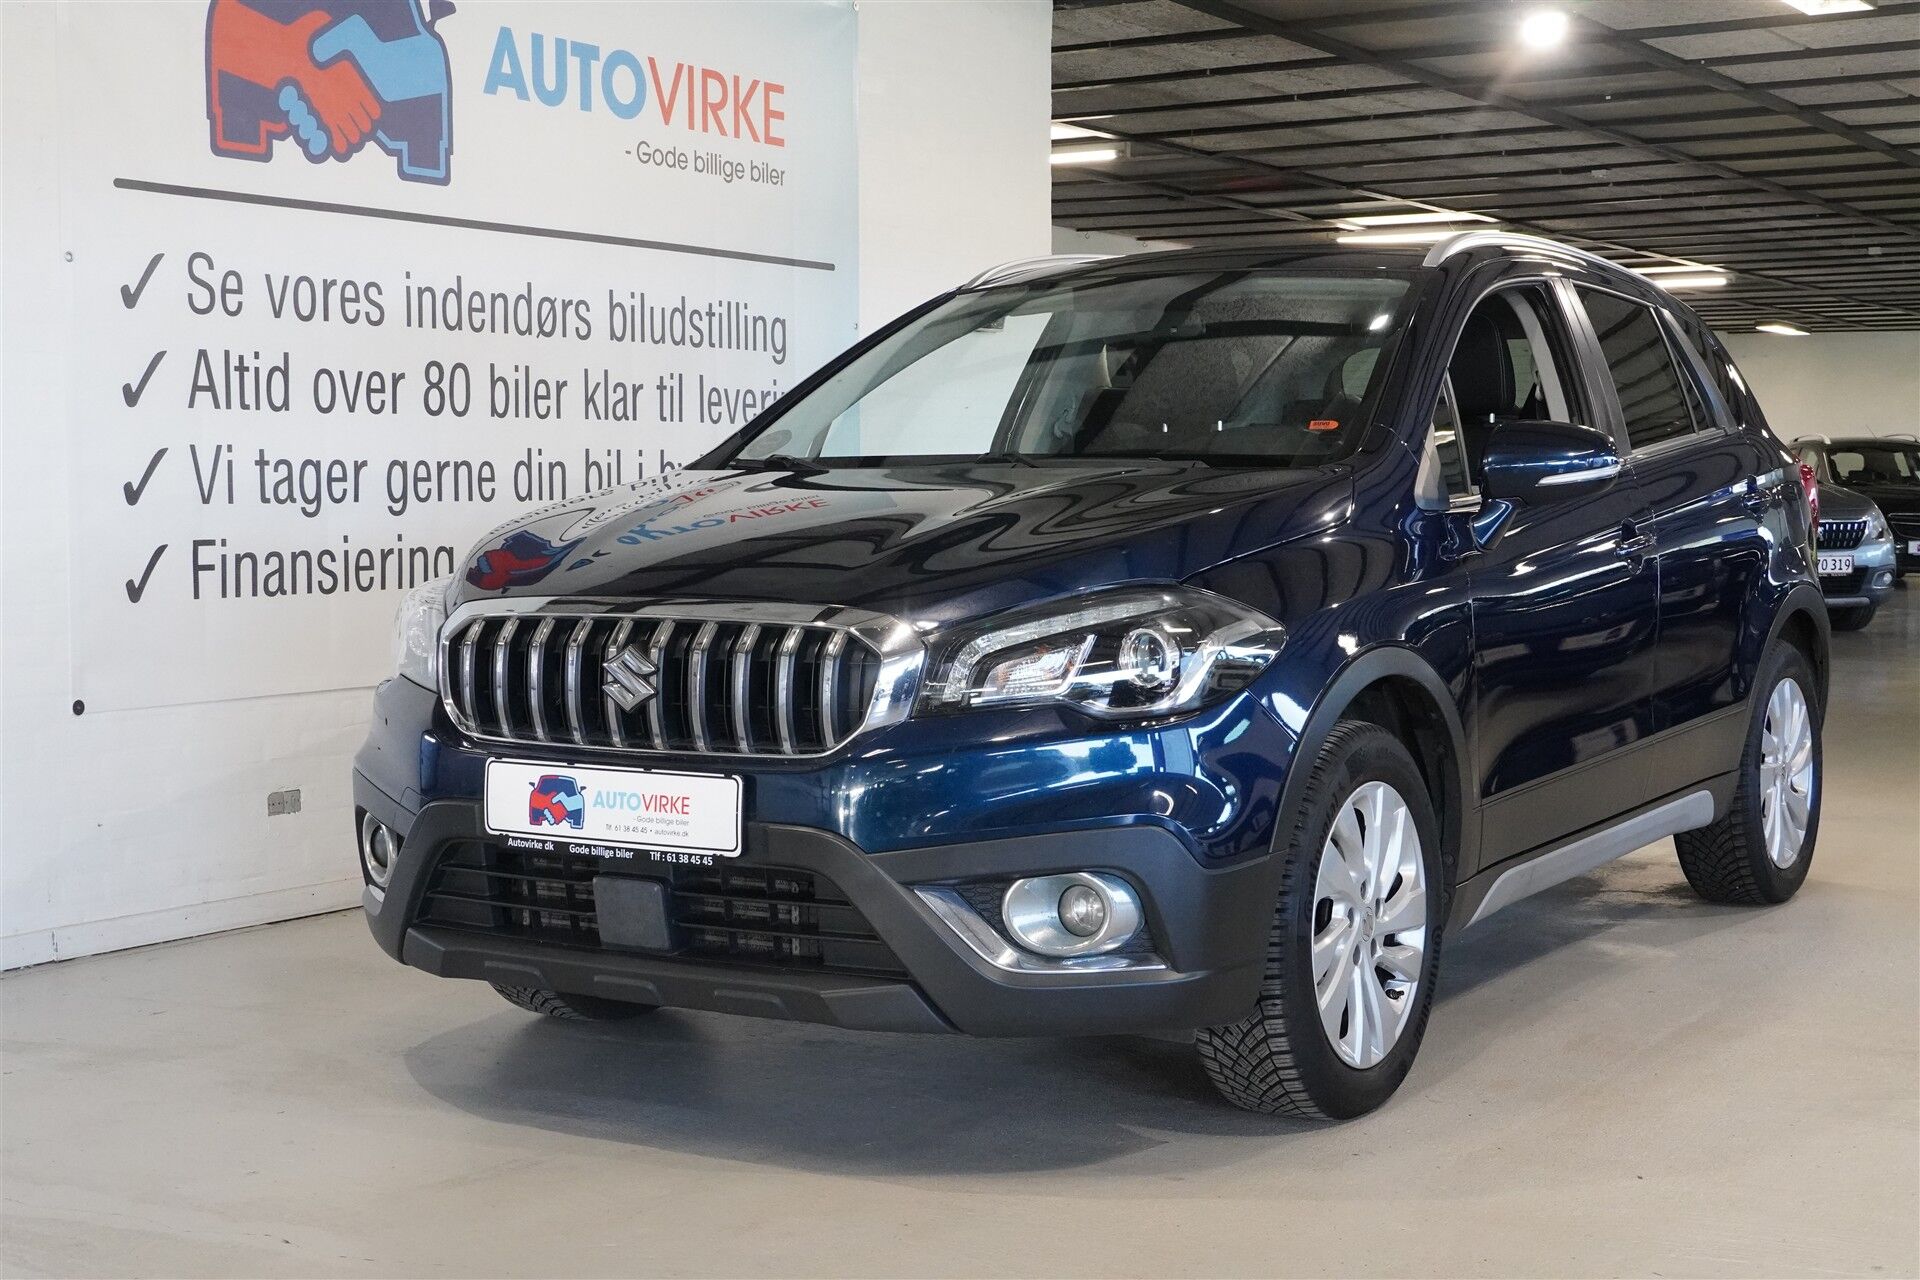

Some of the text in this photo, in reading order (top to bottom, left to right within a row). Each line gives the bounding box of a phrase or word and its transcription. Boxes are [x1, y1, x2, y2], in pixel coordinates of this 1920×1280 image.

[483, 26, 786, 148] AUTOVIRKE
[636, 140, 689, 170] Gode
[693, 149, 745, 183] billige
[750, 160, 785, 187] biler
[187, 252, 786, 364] Se vores indendørs biludstilling
[188, 349, 290, 412] Altid
[314, 369, 406, 416] over
[424, 361, 471, 417] 80
[490, 363, 568, 419] biler
[584, 368, 644, 422] klar
[657, 373, 683, 422] til
[190, 445, 234, 505] Vi
[255, 449, 368, 518] tager
[387, 459, 496, 516] gerne
[513, 448, 567, 503] din
[585, 448, 621, 494] bil
[1830, 558, 1851, 571] 319
[593, 790, 690, 815] AUTOVIRKE
[637, 815, 654, 824] Gode
[508, 838, 543, 850] Autovirke
[544, 841, 555, 851] dk
[569, 844, 590, 855] Gode
[591, 846, 614, 858] billige
[615, 848, 634, 859] biler
[666, 853, 677, 863] 61
[678, 854, 689, 864] 38
[690, 855, 701, 865] 45
[702, 856, 713, 866] 45
